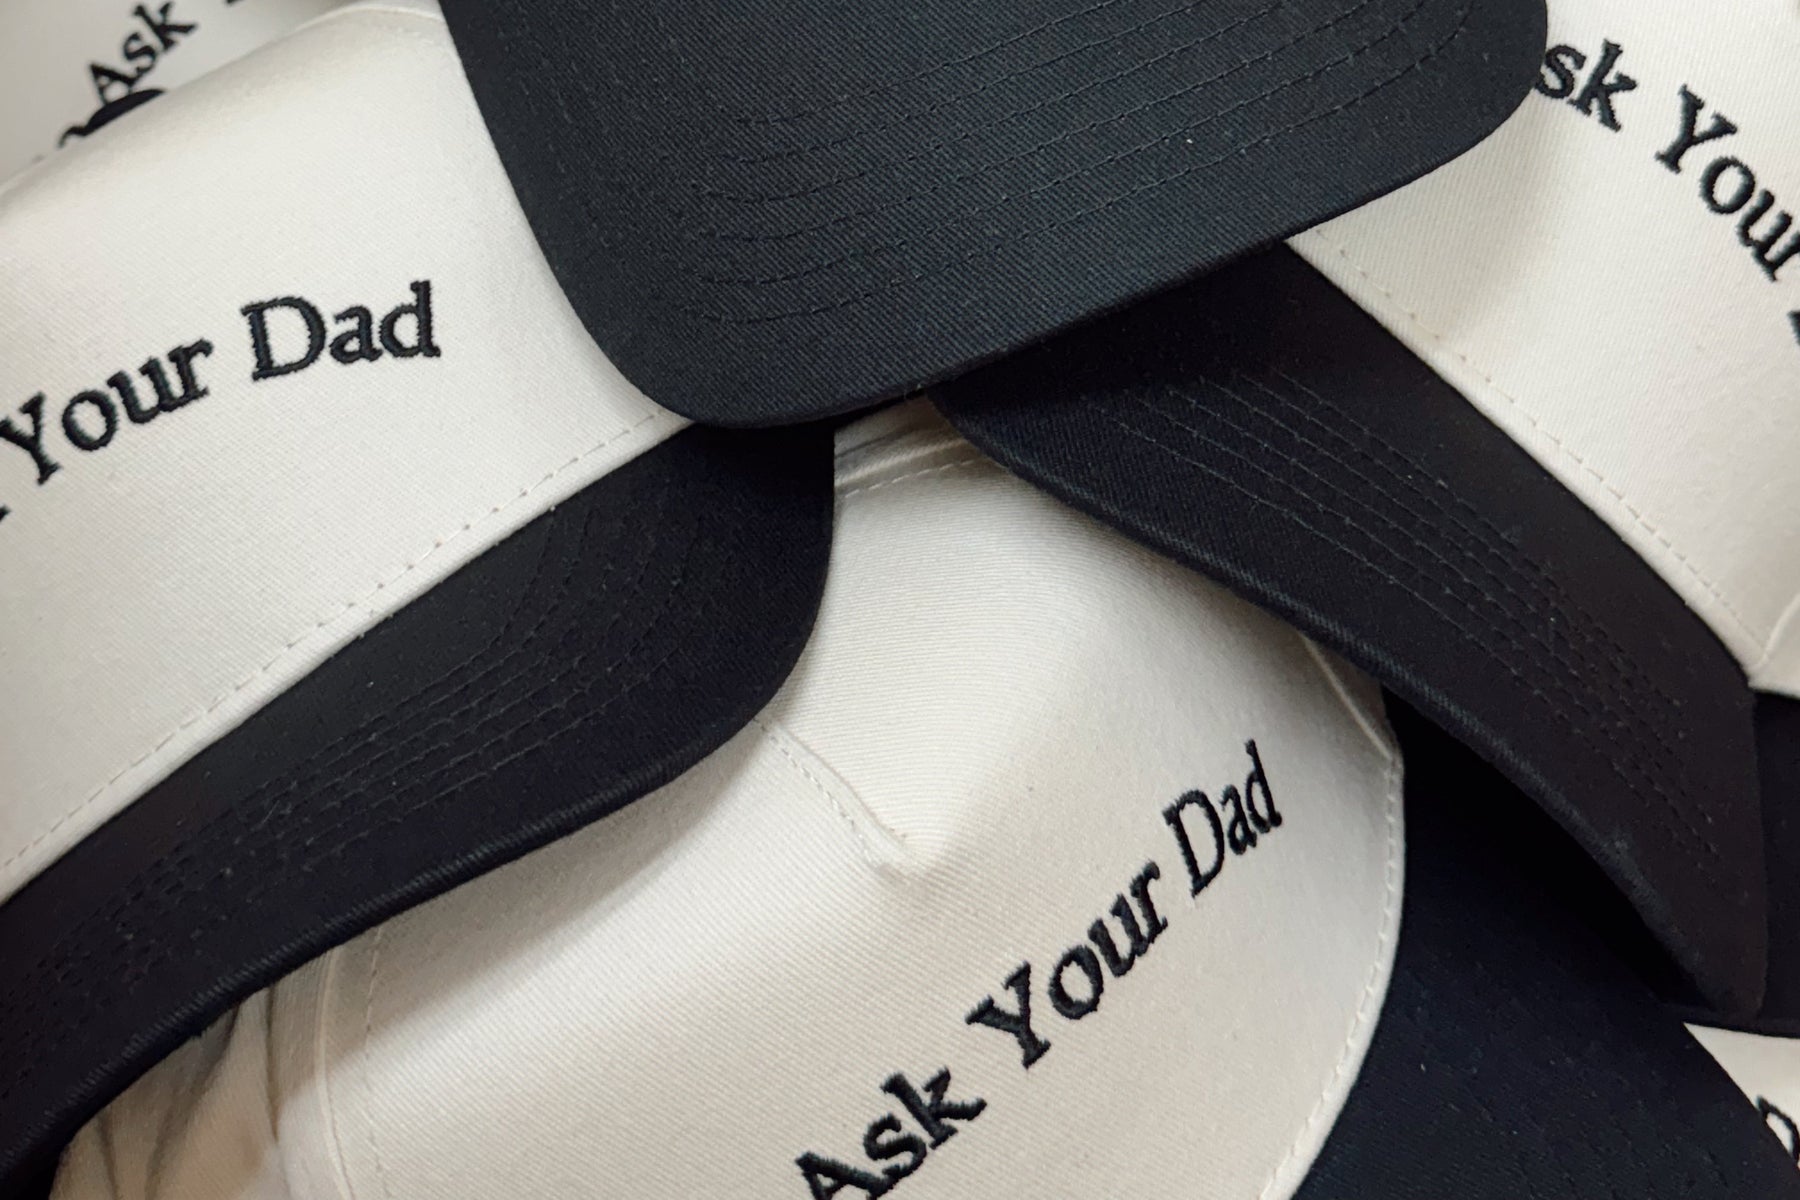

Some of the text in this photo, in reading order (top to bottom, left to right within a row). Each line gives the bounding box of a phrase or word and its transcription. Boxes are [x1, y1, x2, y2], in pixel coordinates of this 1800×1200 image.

[88, 0, 198, 106] Ask
[1535, 38, 1637, 132] sk
[0, 279, 441, 486] Your Dad
[795, 738, 1282, 1200] Ask Your Dad
